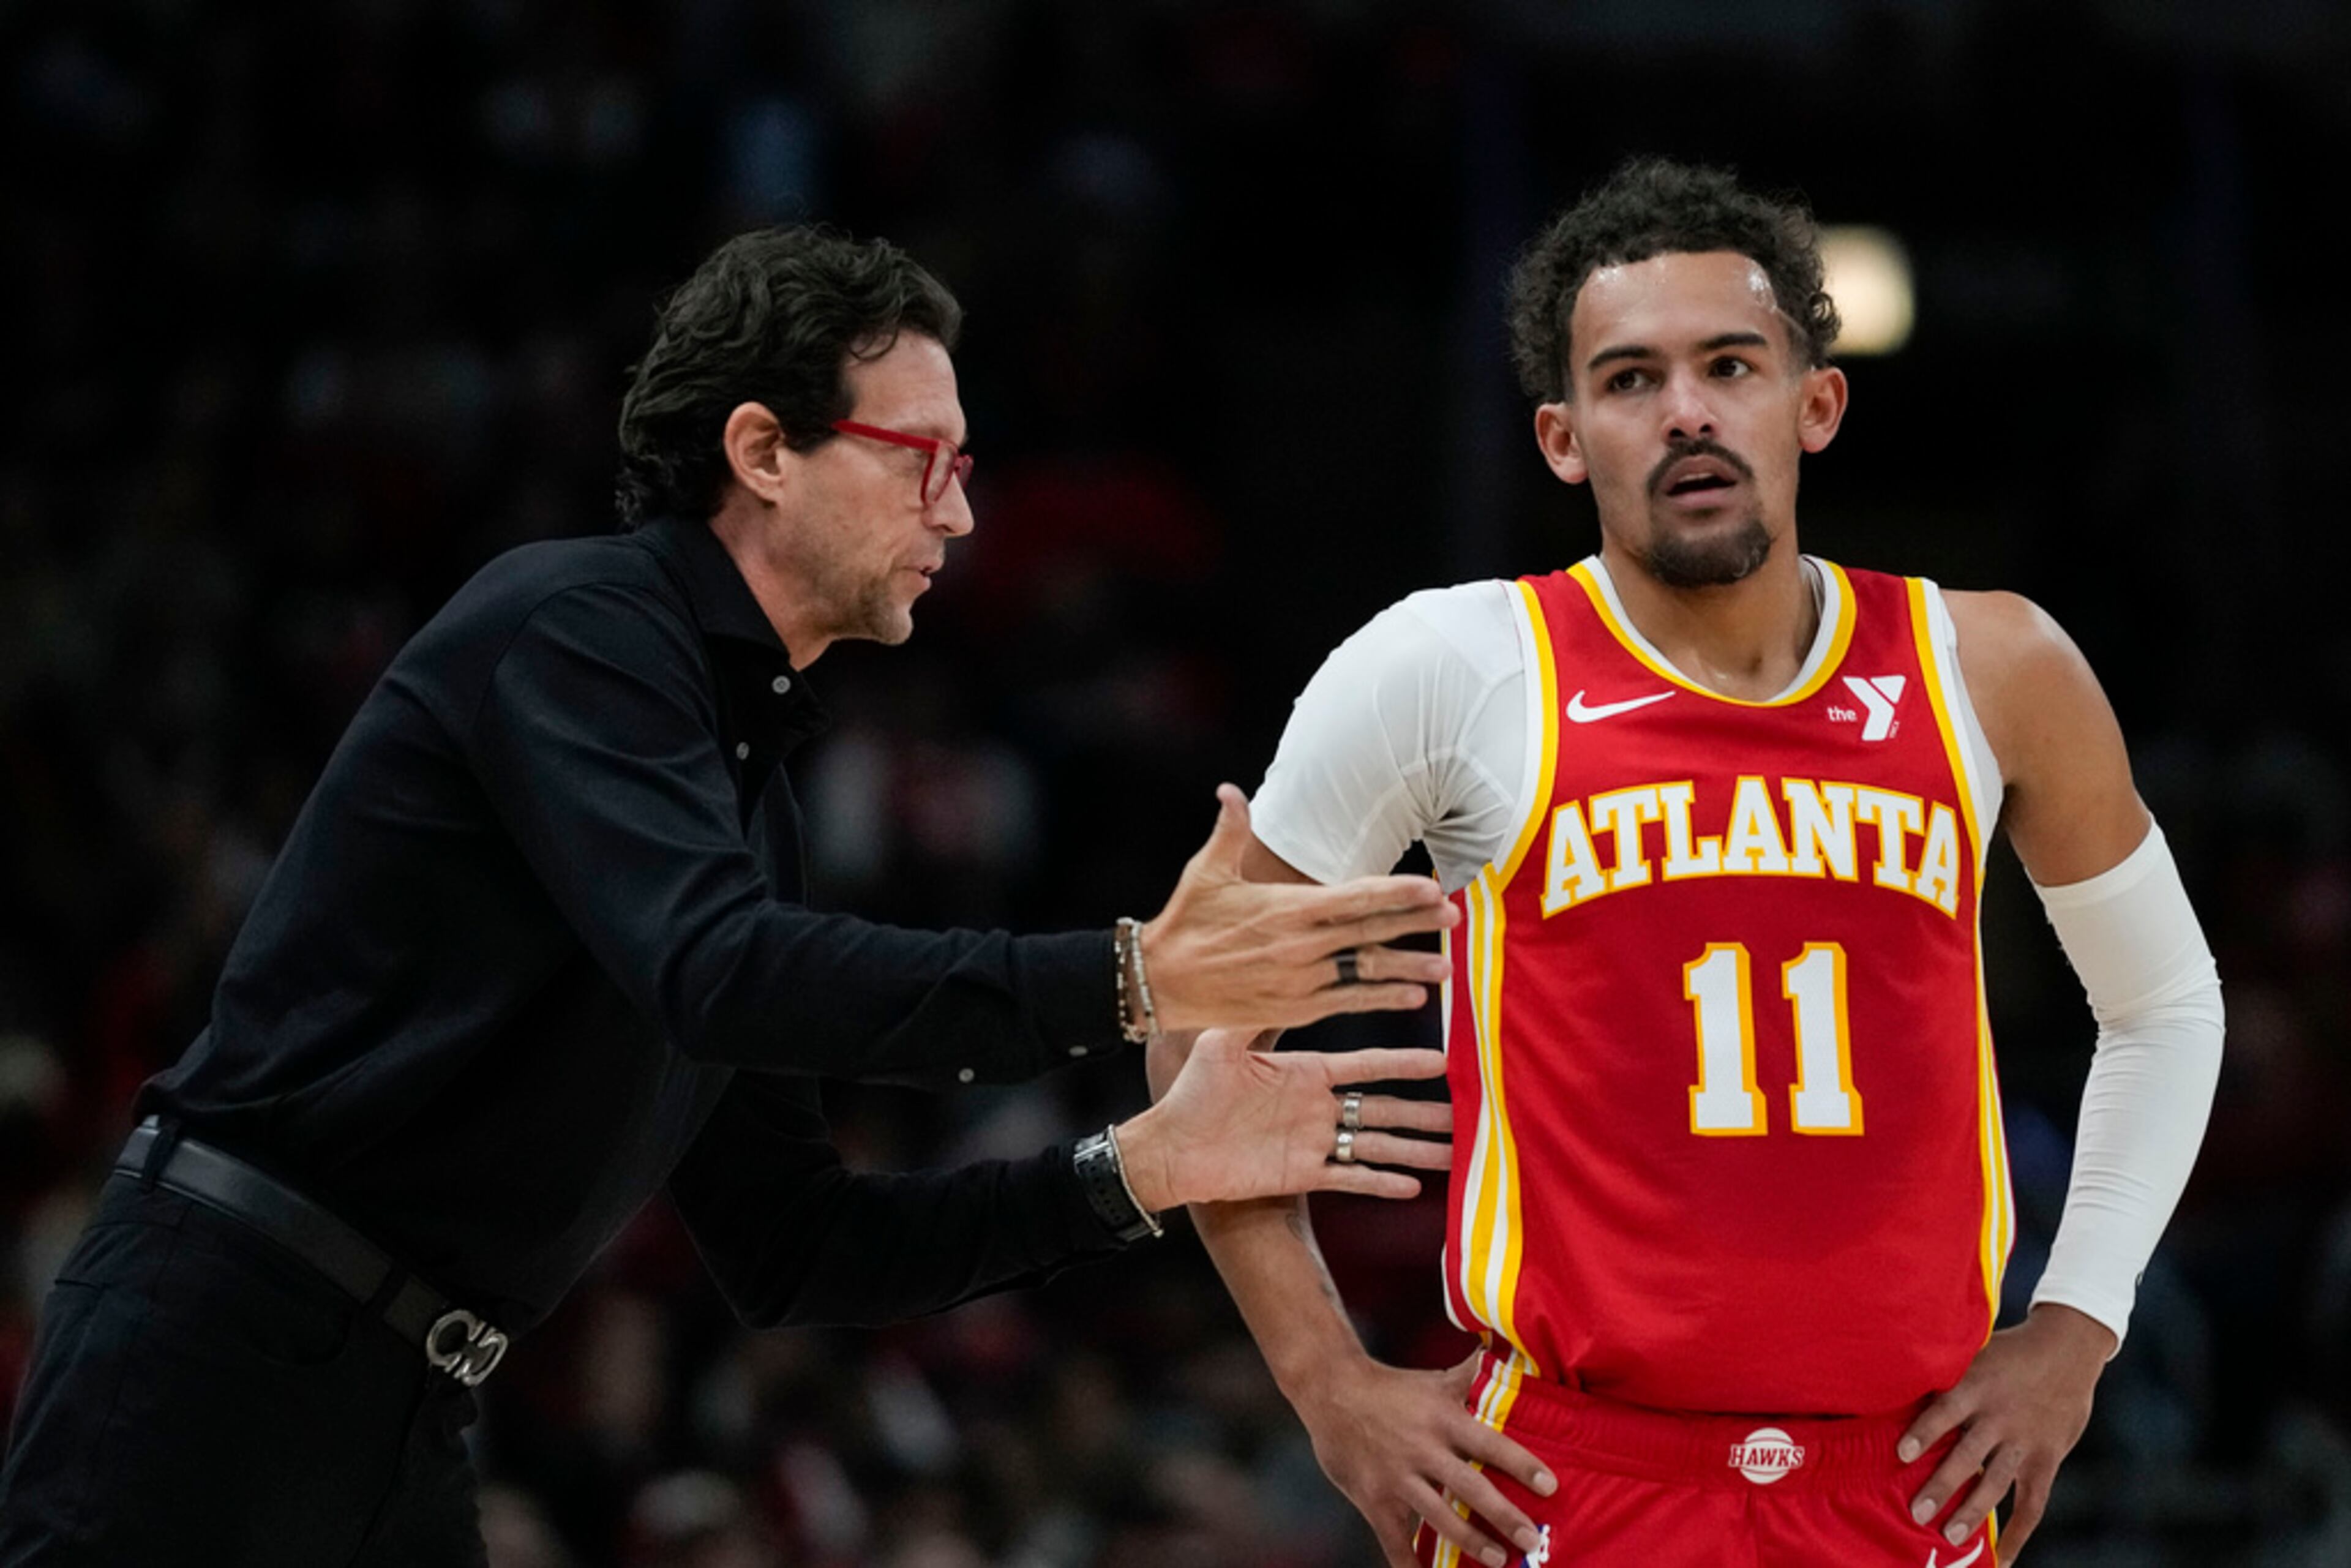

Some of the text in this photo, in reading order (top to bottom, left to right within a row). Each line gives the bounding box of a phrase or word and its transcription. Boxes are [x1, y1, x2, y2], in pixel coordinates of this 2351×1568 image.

[1826, 706, 1858, 722] the
[1842, 675, 1906, 741] Y
[1540, 775, 1960, 920] ATLANTA
[1683, 942, 1864, 1136] 11
[1729, 1445, 1804, 1468] HAWKS
